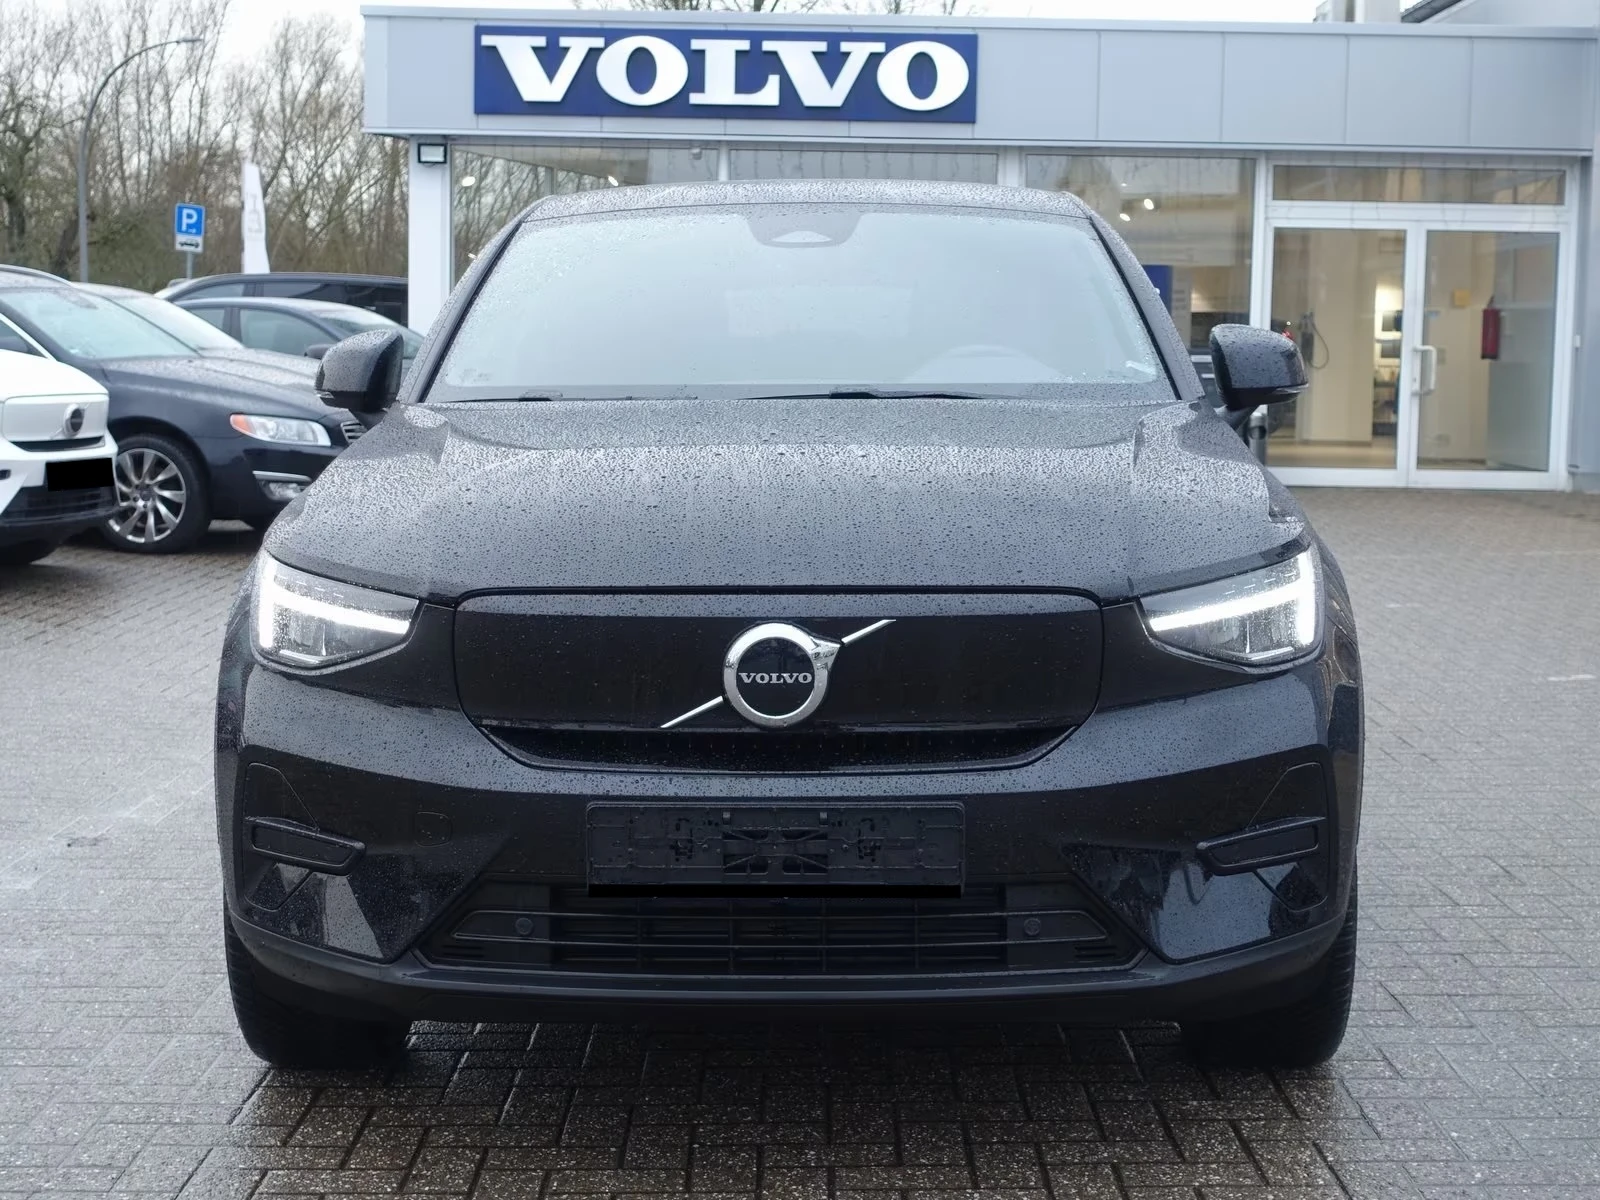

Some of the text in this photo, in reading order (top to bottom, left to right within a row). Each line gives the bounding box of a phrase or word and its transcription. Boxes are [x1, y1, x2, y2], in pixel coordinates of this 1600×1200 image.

[481, 35, 969, 111] VOLVO
[182, 208, 198, 232] P
[738, 672, 813, 684] VOLVO
